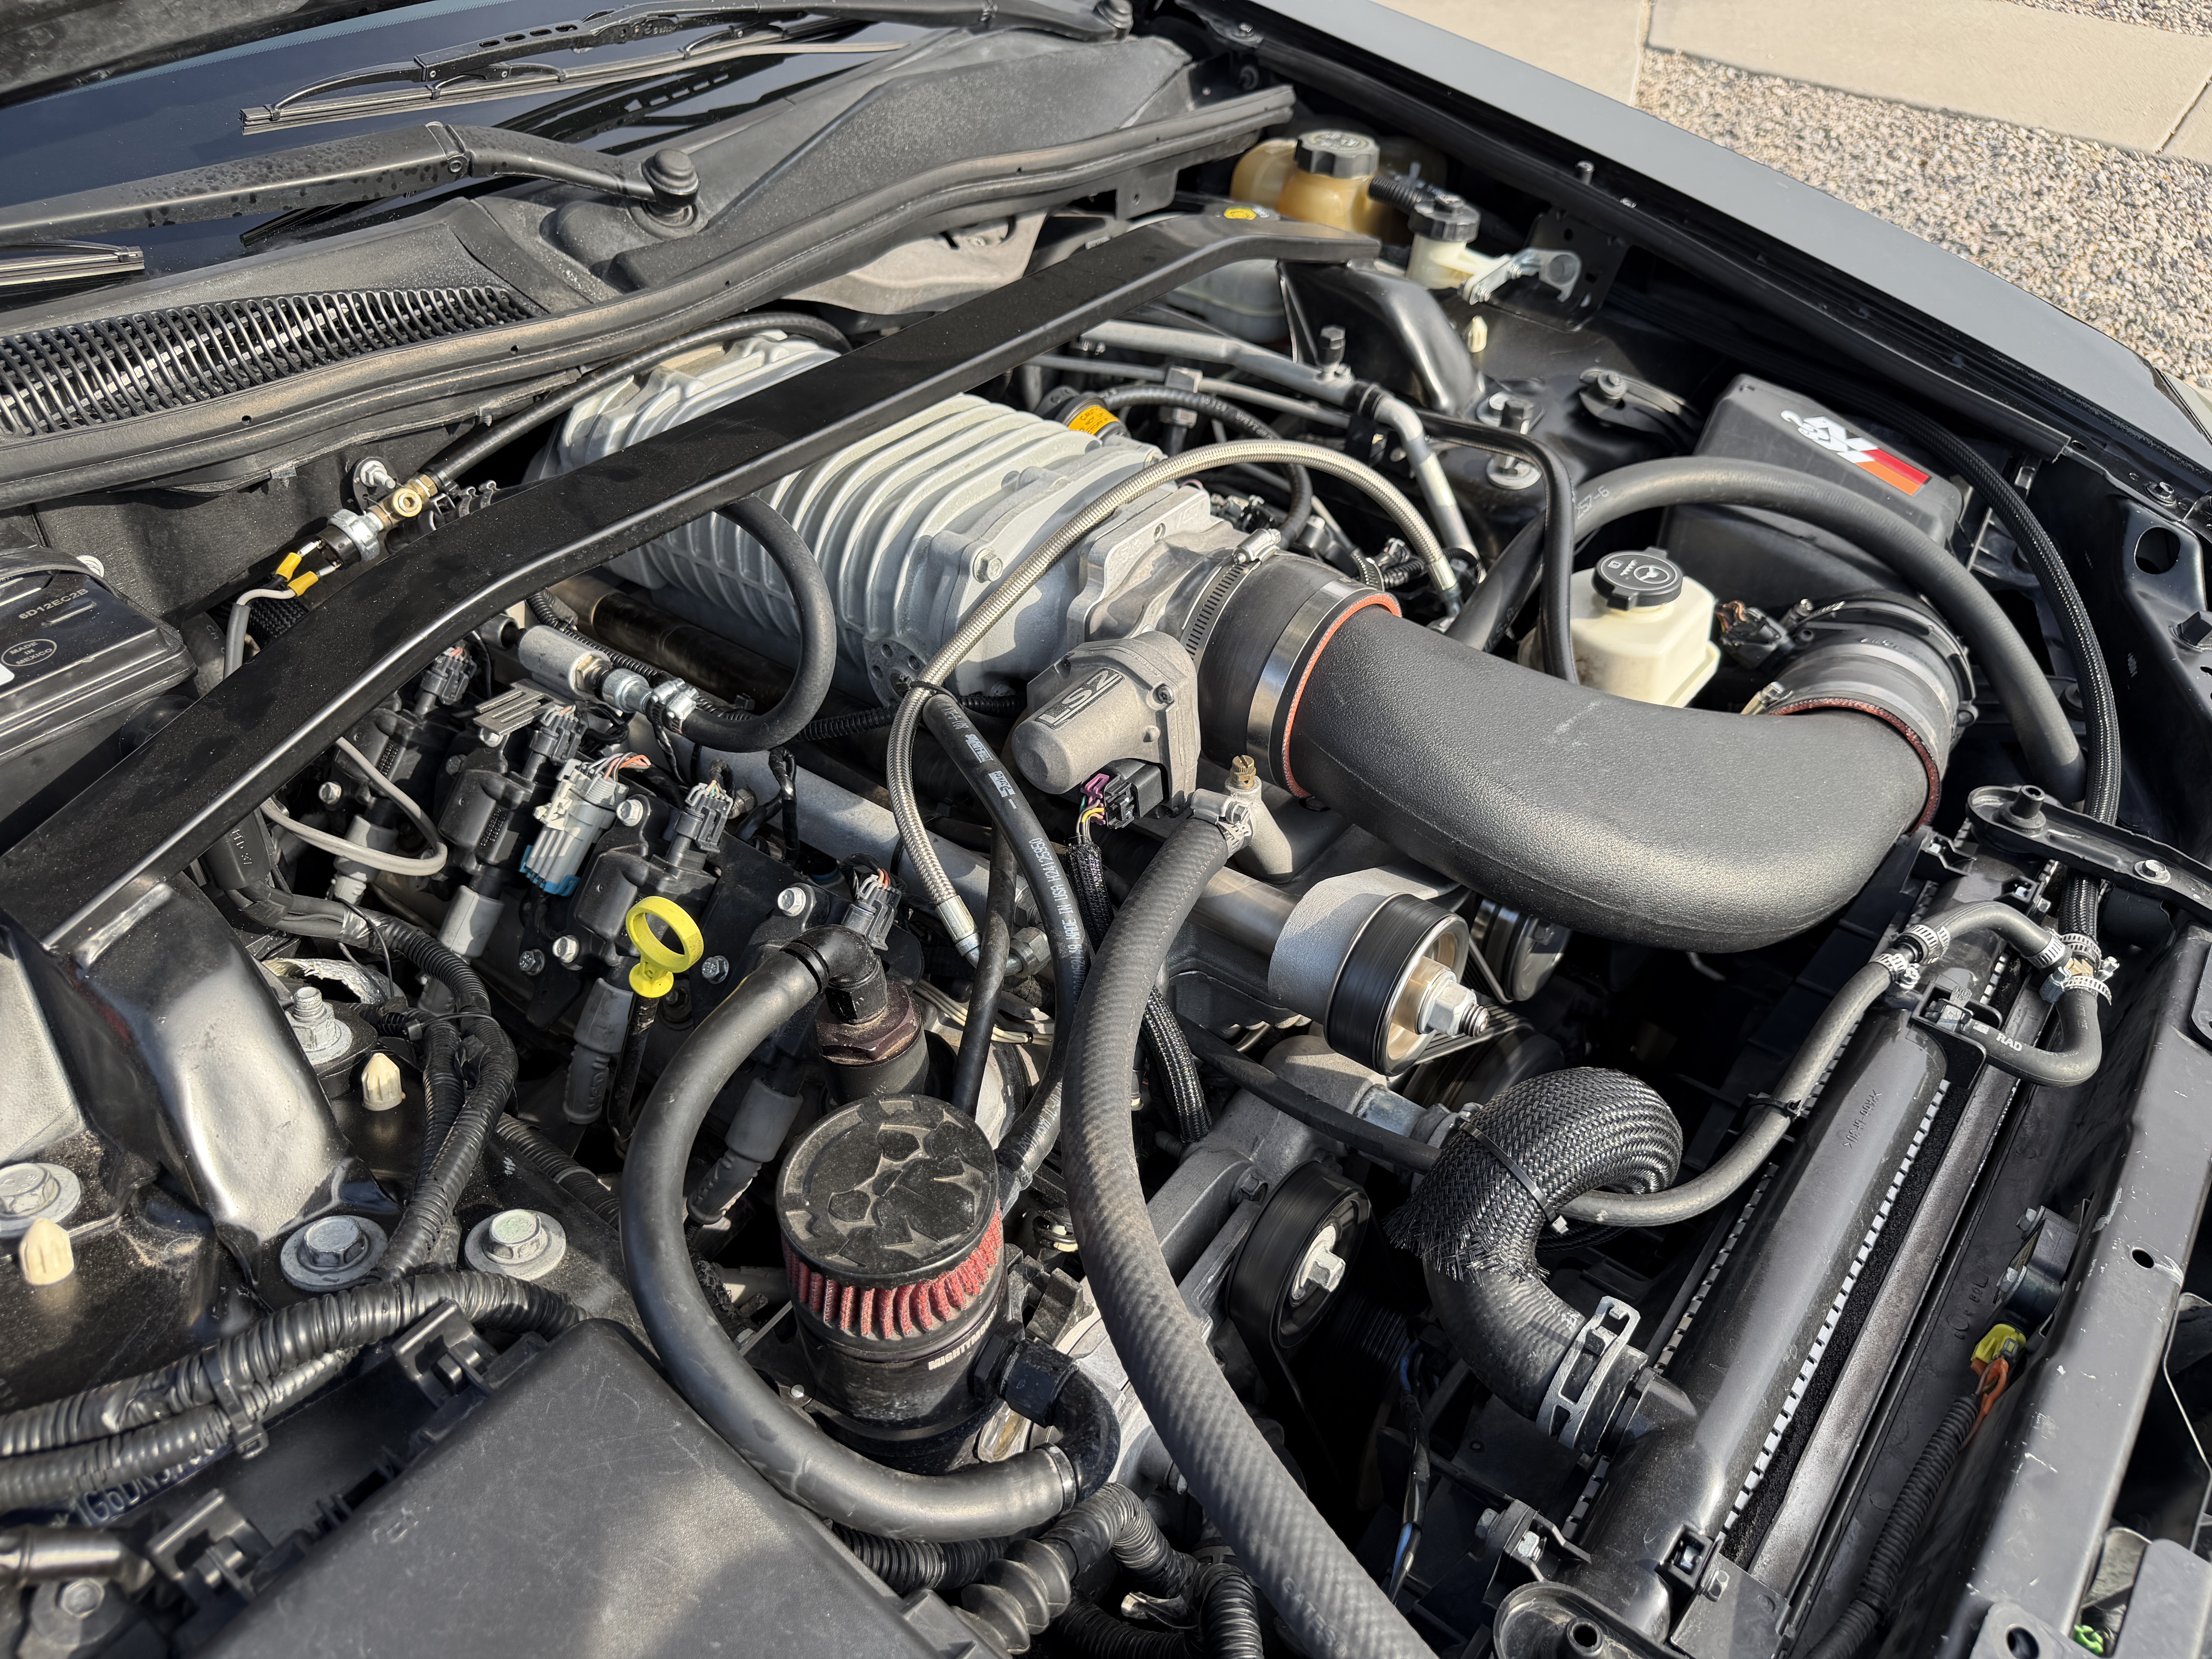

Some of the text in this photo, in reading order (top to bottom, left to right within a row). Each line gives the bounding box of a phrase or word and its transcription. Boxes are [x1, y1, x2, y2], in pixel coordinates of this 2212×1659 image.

[1781, 410, 1879, 464] K&N
[19, 589, 89, 619] 6D12EC2B
[10, 641, 38, 654] MADE
[16, 648, 53, 665] MEXICO
[1039, 670, 1118, 723] LS2
[990, 771, 1014, 795] Parker
[1029, 837, 1061, 882] H24125950
[1050, 883, 1068, 901] USA
[1059, 904, 1074, 916] IN
[1061, 919, 1081, 940] MADE
[1996, 1033, 2022, 1052] RAD
[1282, 1576, 1336, 1647] GATES
